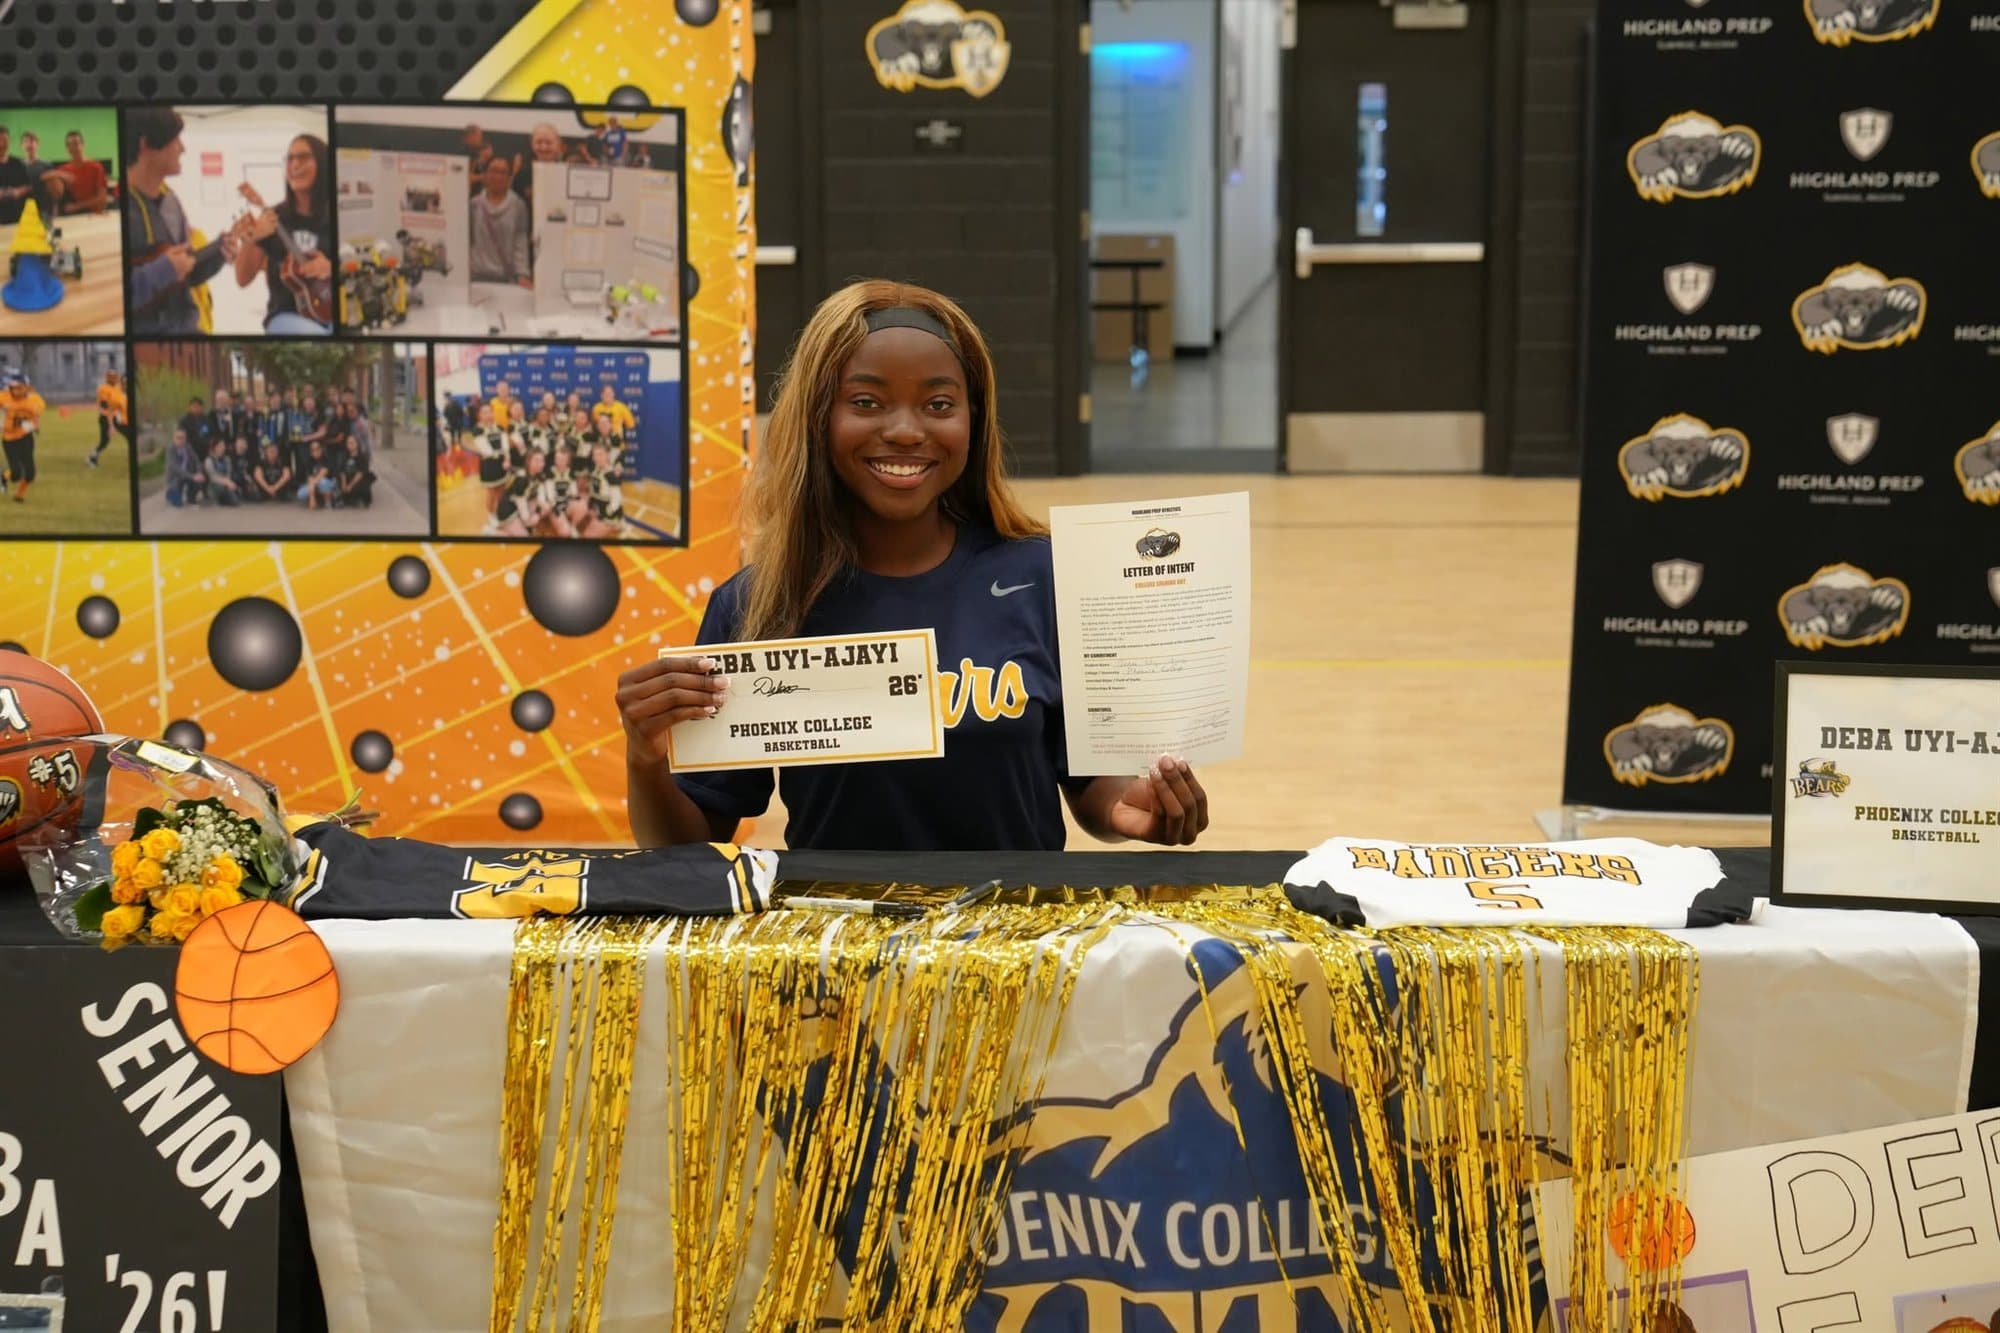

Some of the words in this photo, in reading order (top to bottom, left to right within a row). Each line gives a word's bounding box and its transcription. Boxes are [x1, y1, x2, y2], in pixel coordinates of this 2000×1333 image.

[1623, 18, 1722, 36] HIGHLAND
[1726, 17, 1773, 34] PREP
[1790, 171, 1889, 188] HIGHLAND
[1893, 171, 1940, 187] PREP
[1615, 324, 1712, 340] HIGHLAND
[1715, 324, 1761, 340] PREP
[1777, 474, 1875, 491] HIGHLAND
[1879, 475, 1924, 491] PREP
[1123, 566, 1153, 578] LETTER
[1155, 564, 1166, 576] OF
[1167, 562, 1195, 574] INTENT
[1604, 617, 1699, 634] HIGHLAND
[1703, 619, 1749, 635] PREP
[703, 652, 756, 676] EBA
[764, 643, 899, 672] UYI-AJAYI
[730, 720, 798, 738] PHOENIX
[804, 716, 872, 733] COLLEGE
[764, 738, 840, 753] BASKETBALL
[1821, 726, 1893, 751] DEBA
[1790, 777, 1846, 798] BEARS
[1855, 806, 1933, 823] PHOENIX
[1940, 809, 2000, 826] COLLE
[1892, 829, 1980, 844] BASKETBALL
[1347, 846, 1642, 886] BADGERS
[81, 981, 281, 1230] SENIOR
[1767, 1116, 2000, 1275] DE
[1165, 1198, 1399, 1270] COLLEG
